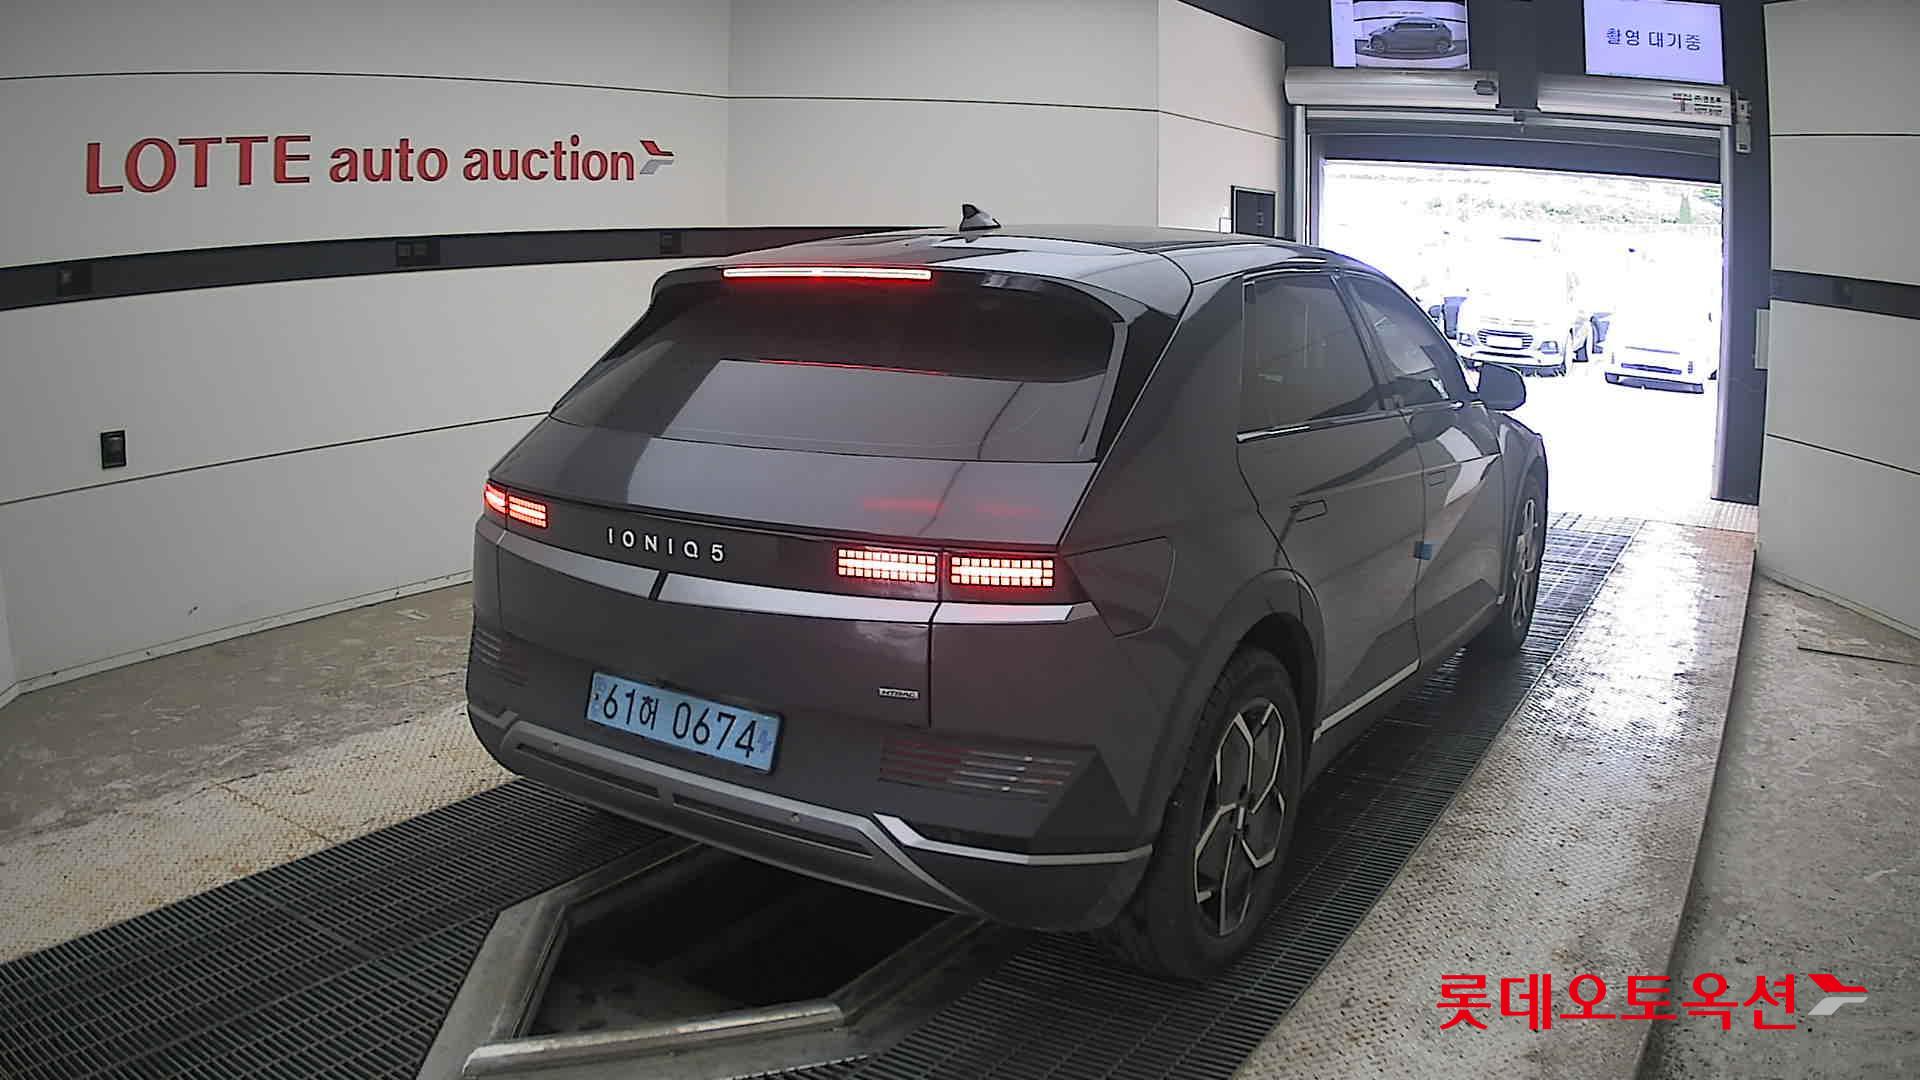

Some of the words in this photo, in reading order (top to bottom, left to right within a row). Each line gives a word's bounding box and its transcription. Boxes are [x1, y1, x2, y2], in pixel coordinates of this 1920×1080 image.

[1648, 31, 1701, 51] 대기중
[86, 135, 310, 194] LOTTE
[329, 139, 448, 183] auto
[463, 135, 635, 182] auction
[607, 527, 699, 559] IONIQ
[711, 544, 724, 562] 5
[603, 684, 659, 730] 61허
[672, 702, 757, 758] 0674
